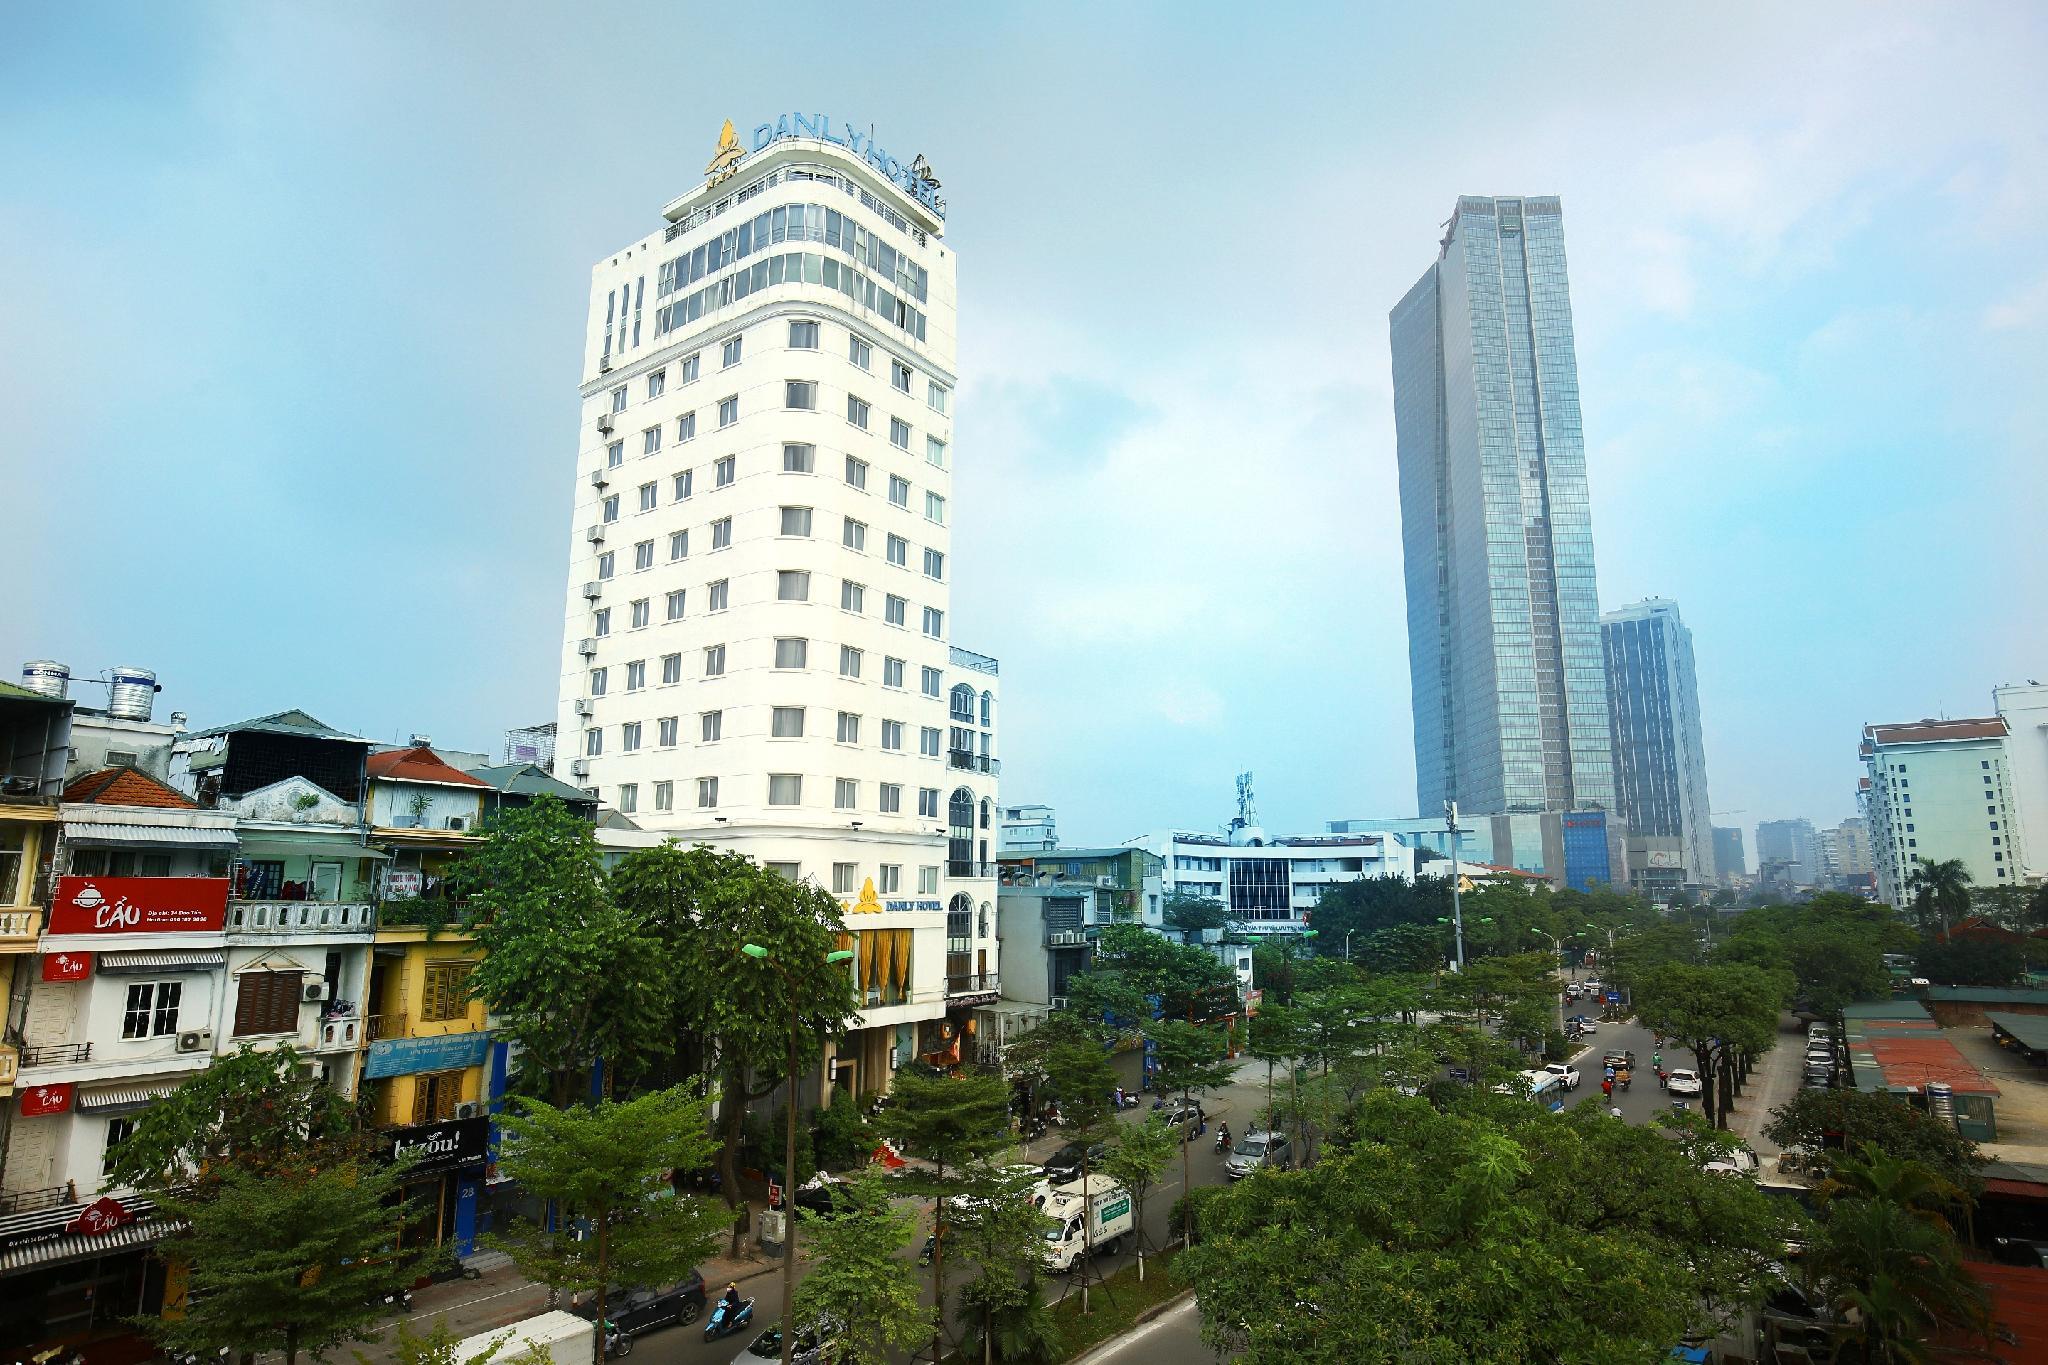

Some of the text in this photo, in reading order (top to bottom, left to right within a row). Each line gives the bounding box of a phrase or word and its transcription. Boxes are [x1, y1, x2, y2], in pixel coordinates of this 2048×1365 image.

[753, 111, 865, 152] DANLY
[885, 900, 943, 911] DANLY HOTEL
